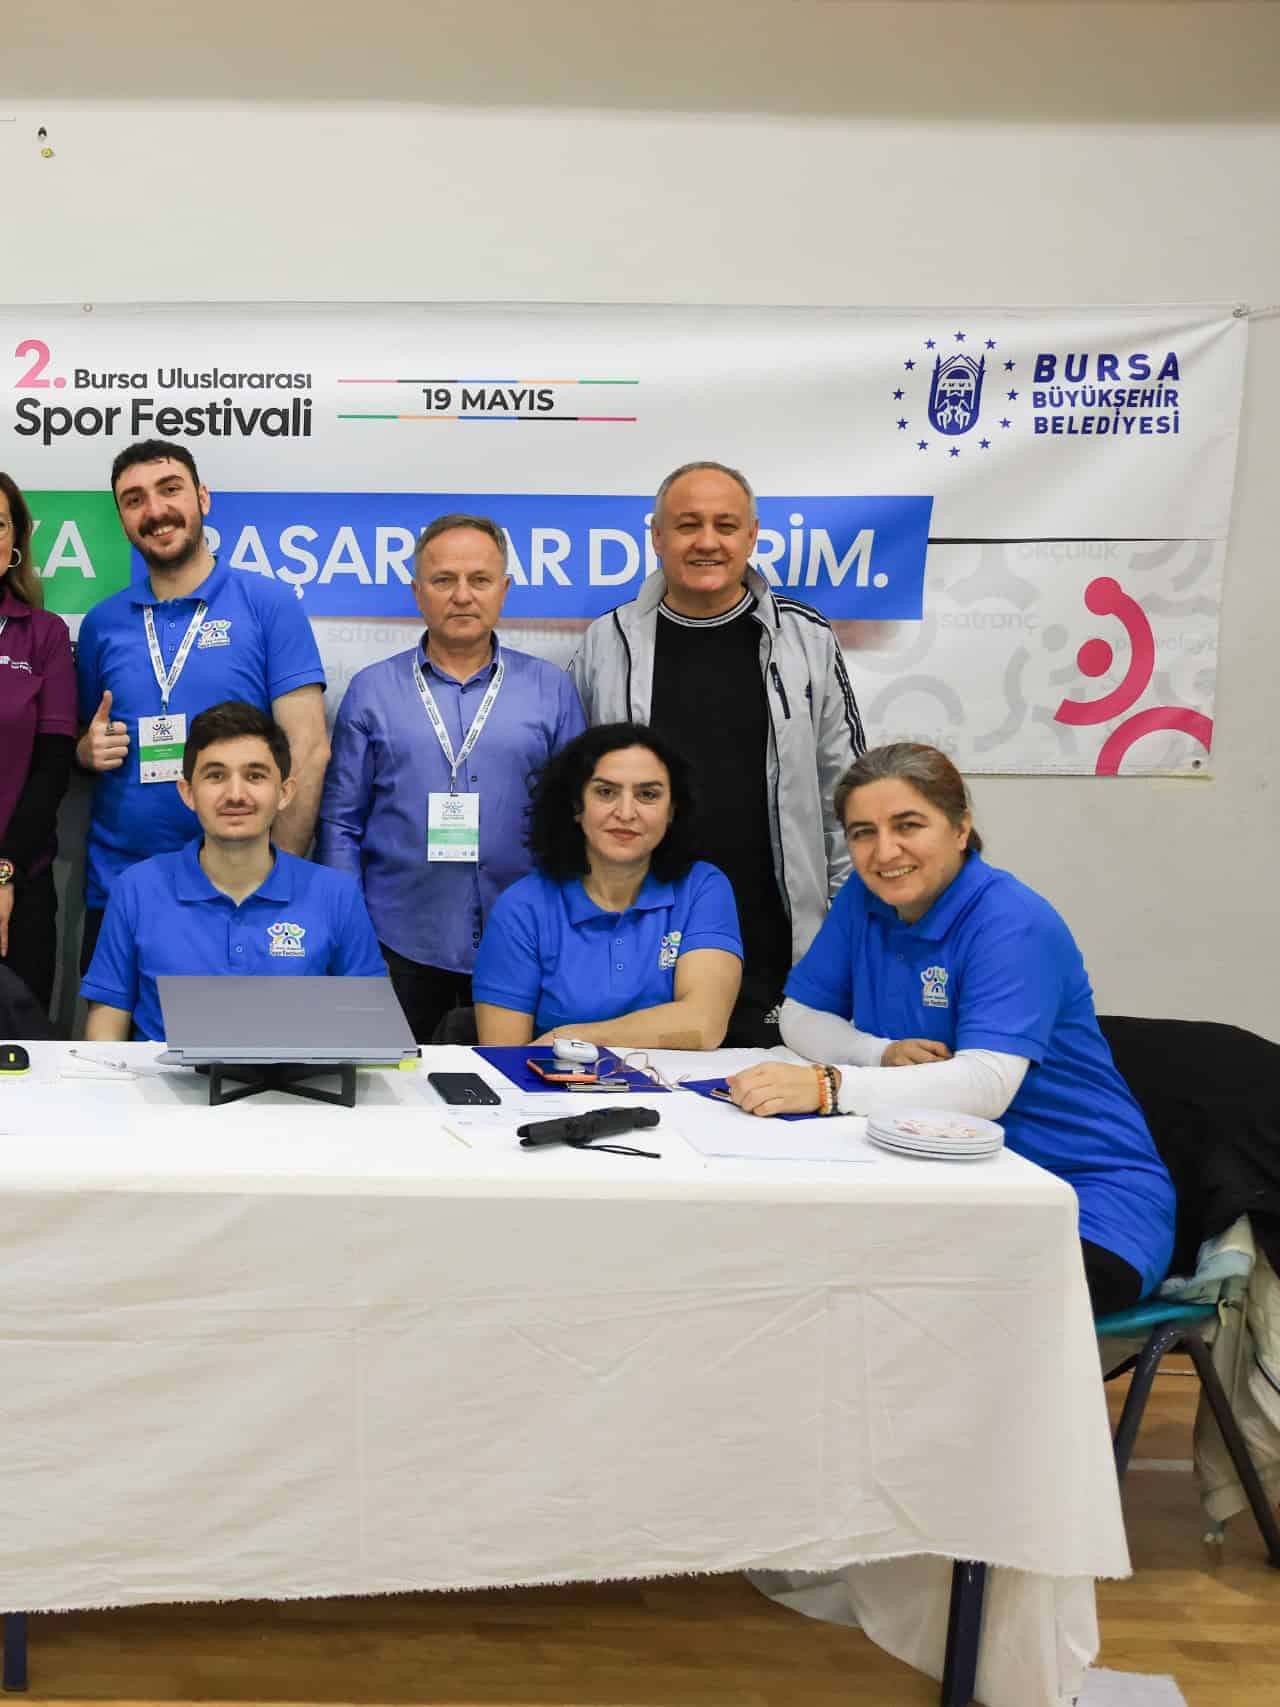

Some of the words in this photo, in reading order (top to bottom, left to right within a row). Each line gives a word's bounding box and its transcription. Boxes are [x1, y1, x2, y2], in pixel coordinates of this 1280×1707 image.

[15, 339, 66, 388] 2.
[74, 368, 148, 389] Bursa
[157, 367, 312, 389] Uluslararası
[1032, 352, 1181, 383] BURSA
[422, 388, 452, 410] 19
[461, 388, 555, 411] MAYIS
[1032, 383, 1180, 412] BÜYÜKŞEHİR
[13, 397, 122, 445] Spor
[130, 397, 313, 438] Festivali
[1033, 409, 1180, 435] BELEDİYESİ
[588, 512, 889, 588] DİRİM.
